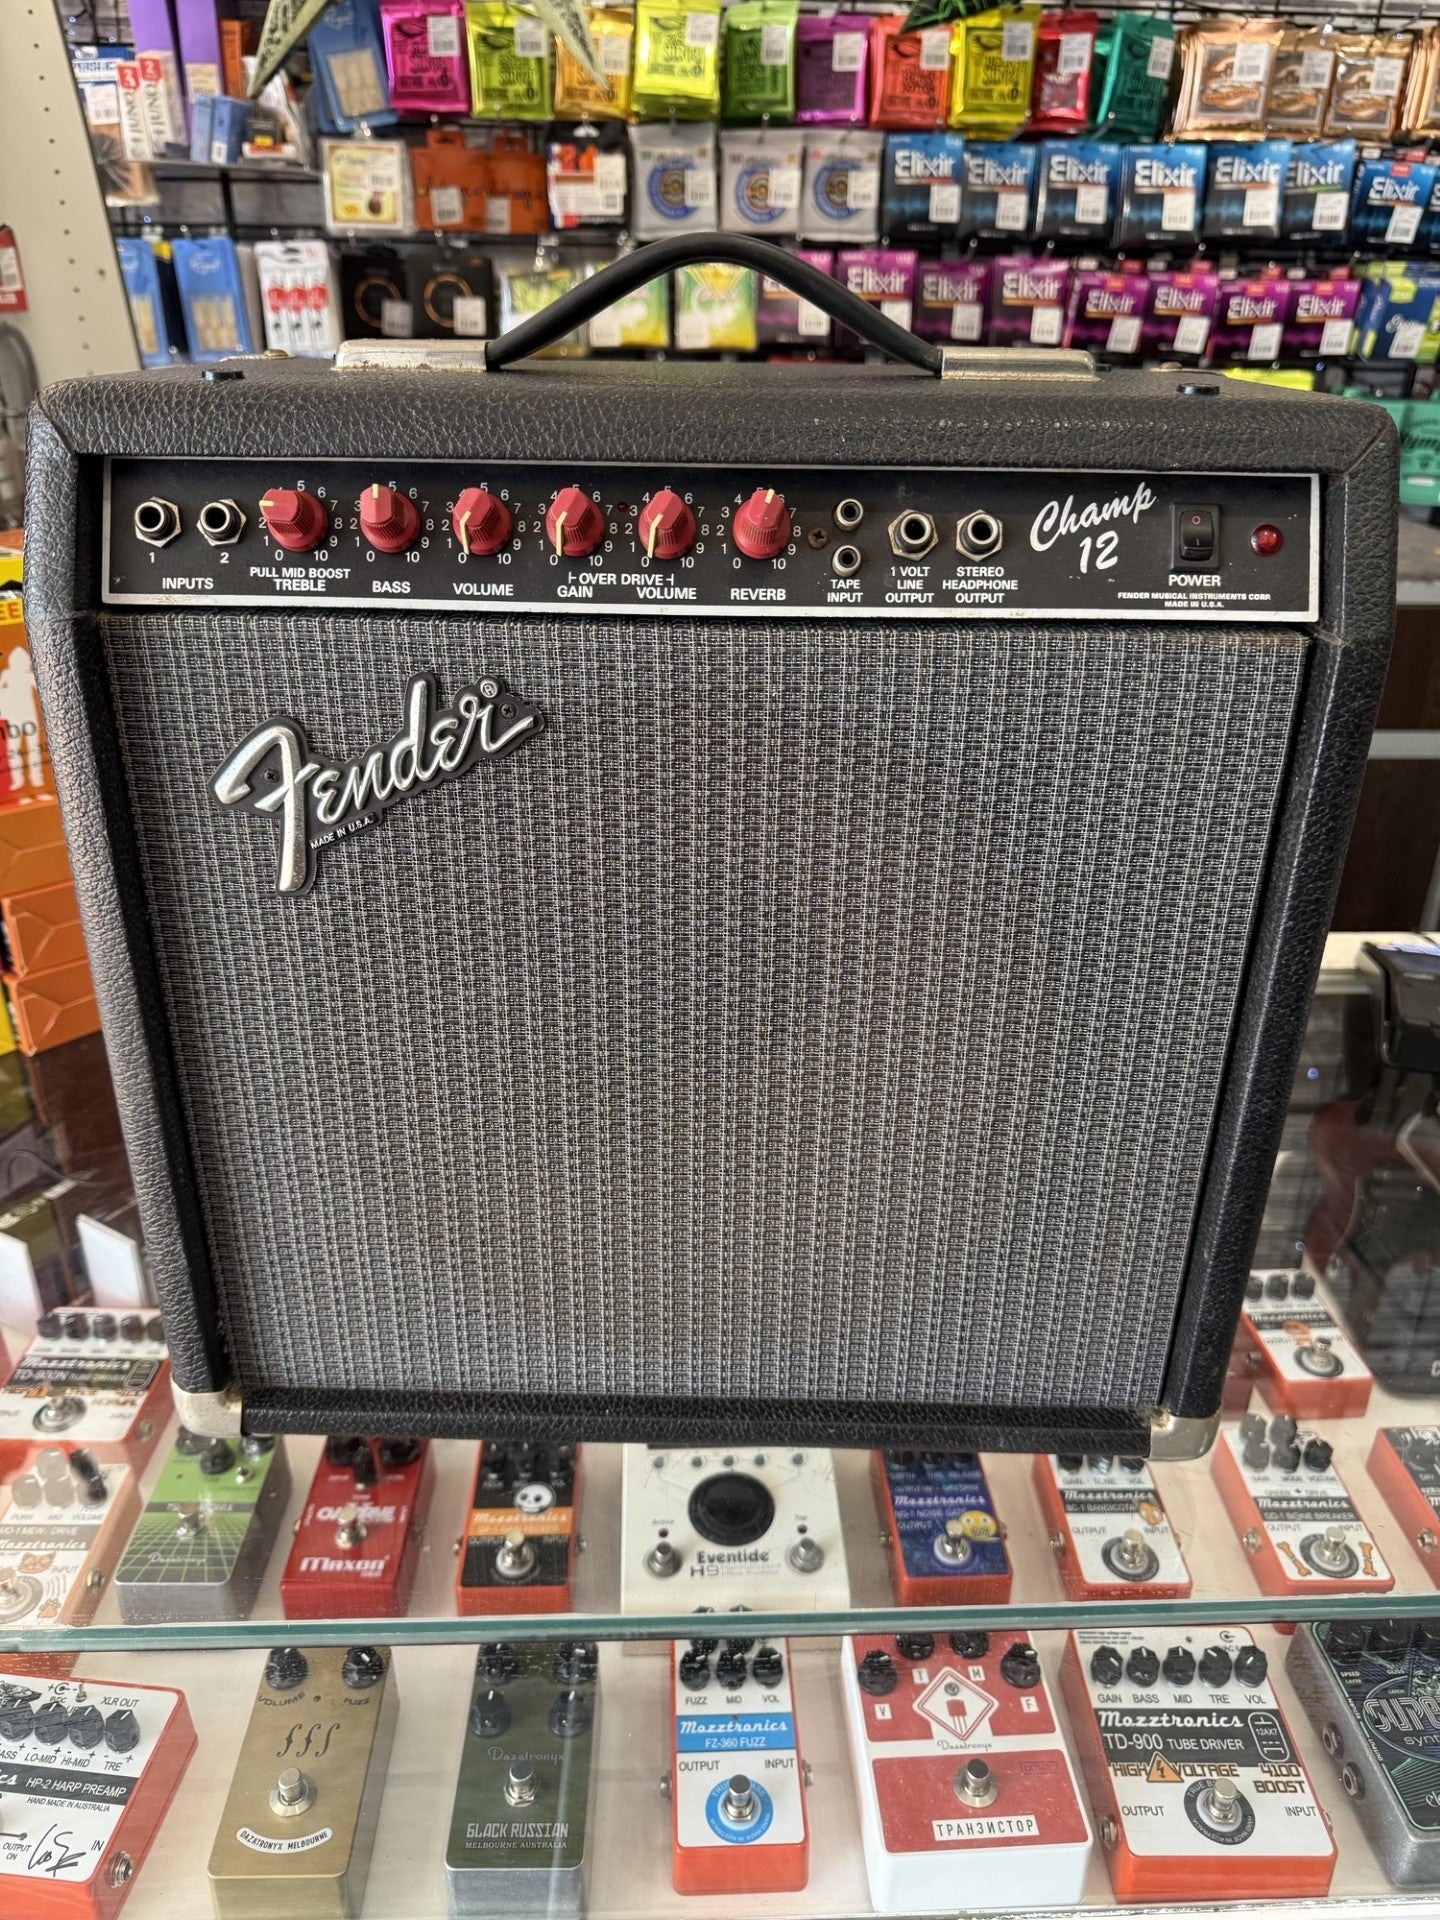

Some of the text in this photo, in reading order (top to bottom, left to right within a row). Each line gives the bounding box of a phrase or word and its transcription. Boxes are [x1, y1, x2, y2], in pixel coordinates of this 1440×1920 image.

[895, 149, 957, 179] Elixir
[968, 154, 1029, 186] Elixir
[1050, 154, 1110, 183] Elixir
[1215, 155, 1282, 183] Elixir
[1134, 158, 1197, 187] Elixir
[1369, 176, 1420, 200] Elixir
[847, 264, 909, 295] Elixir
[922, 272, 982, 301] Elixir
[1002, 271, 1062, 301] Elixir
[1086, 288, 1136, 313] Elixir
[1154, 286, 1207, 311] Elixir
[1228, 295, 1279, 319] Elixir
[1297, 294, 1347, 318] Elixir
[480, 483, 488, 493] 5
[501, 490, 509, 500] 6
[446, 502, 454, 513] 3
[514, 503, 521, 514] 7
[1030, 481, 1157, 552] Champ
[442, 519, 450, 531] 2
[518, 521, 526, 532] 8
[447, 537, 452, 548] 1
[513, 539, 521, 550] 9
[149, 553, 155, 563] 1
[1078, 530, 1119, 574] 12
[220, 553, 229, 564] 2
[458, 553, 467, 564] 0
[497, 554, 511, 565] 10
[250, 567, 350, 579] PULL MID BOOST
[899, 567, 930, 577] VOLT
[957, 567, 1004, 577] STEREO
[162, 578, 213, 590] INPUTS
[579, 573, 663, 585] OVER DRIVE
[831, 580, 860, 590] TAPE
[897, 580, 923, 590] LINE
[943, 580, 1018, 590] HEADPHONE
[1169, 575, 1221, 587] POWER
[273, 579, 326, 592] TREBLE
[372, 581, 411, 593] BASS
[453, 583, 514, 596] VOLUME
[557, 586, 593, 598] GAIN
[636, 587, 697, 599] VOLUME
[730, 589, 786, 601] REVERB
[827, 593, 863, 603] INPUT
[885, 593, 934, 603] OUTPUT
[955, 593, 1005, 603] OUTPUT
[214, 680, 534, 892] Fender
[310, 816, 374, 849] MADE IN U.S.A.
[697, 1549, 770, 1564] Eventide
[690, 1565, 720, 1577] H9
[101, 1696, 140, 1708] XLR OUT
[258, 1691, 305, 1706] VOLUME
[343, 1697, 370, 1706] FUZZ
[685, 1696, 707, 1705] FUZZ
[726, 1695, 742, 1704] MID
[763, 1694, 780, 1703] VOL
[1097, 1694, 1123, 1704] GAIN
[1132, 1694, 1160, 1704] BASS
[1174, 1694, 1193, 1704] MID
[1209, 1694, 1231, 1705] TRE
[1245, 1694, 1267, 1704] VOL
[1098, 1710, 1245, 1728] Mozztronics
[680, 1719, 788, 1733] Mozztronics
[1255, 1728, 1278, 1736] 12AX7
[705, 1736, 767, 1748] FZ-360 FUZZ
[1103, 1733, 1245, 1750] TD-900 TUBE DRIVER
[487, 1746, 567, 1766] Dazatronyx
[1368, 1739, 1384, 1761] OUTPUT
[25, 1752, 57, 1765] LO-MID
[61, 1756, 90, 1768] HI-MID
[764, 1758, 795, 1769] INPUT
[104, 1761, 122, 1772] TRE
[679, 1760, 721, 1771] OUTPUT
[1112, 1763, 1240, 1777] HIGH VOLTAGE
[1260, 1763, 1302, 1777] 4100
[26, 1777, 127, 1798] HP-2 HARP PREAMP
[1187, 1780, 1206, 1797] TRUE
[1253, 1781, 1305, 1794] BOOST
[27, 1797, 45, 1805] HAND
[45, 1799, 66, 1807] MADE
[73, 1802, 110, 1812] AUSTRALIA
[1122, 1806, 1165, 1816] OUTPUT
[1285, 1806, 1317, 1817] INPUT
[510, 1823, 569, 1838] RUSSIAN
[936, 1819, 1034, 1837] ТРАНЗИСТОР
[91, 1840, 104, 1851] IN
[240, 1830, 329, 1851] DAZATRONYX MELBOURNE
[465, 1841, 568, 1849] MELBOURNE AUSTRALIA
[2, 1842, 32, 1853] OUTPUT
[6, 1853, 18, 1861] ON
